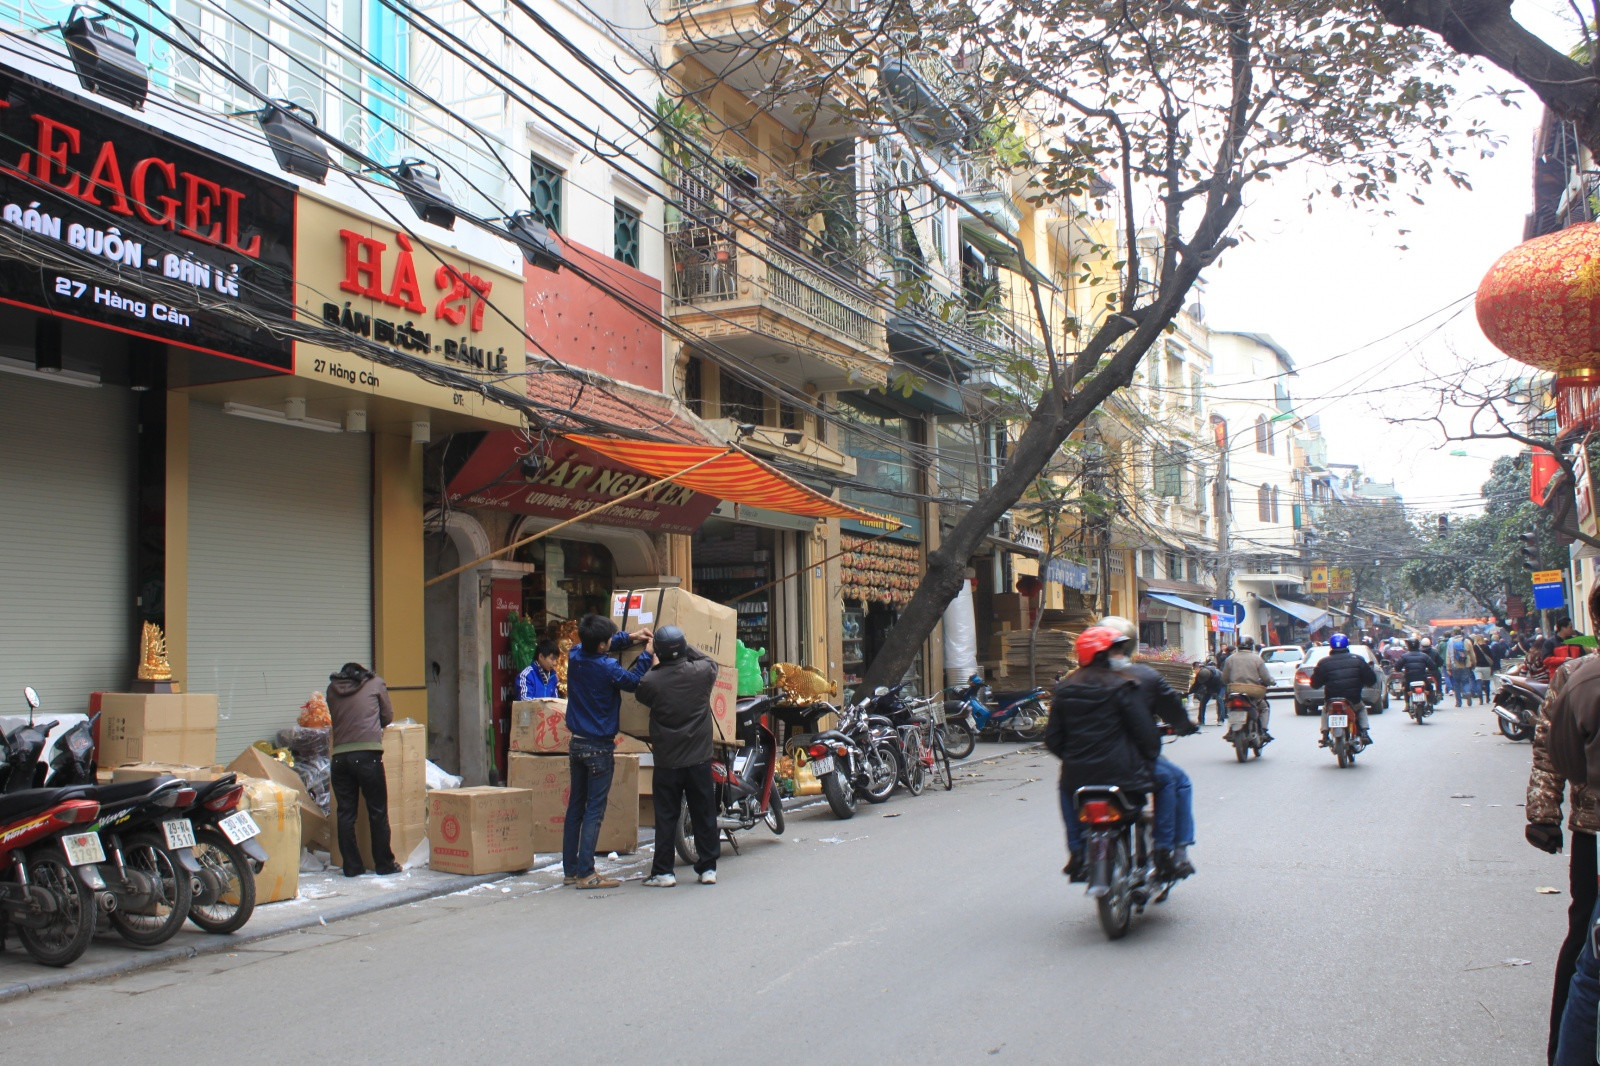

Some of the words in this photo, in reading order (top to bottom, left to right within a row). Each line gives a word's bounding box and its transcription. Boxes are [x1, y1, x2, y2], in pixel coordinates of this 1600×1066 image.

[3, 201, 61, 240] BÁN
[67, 223, 142, 269] BUÔN
[163, 250, 211, 289] BÁN
[55, 277, 87, 299] 27
[94, 286, 147, 318] Hàng
[151, 303, 190, 327] Cân
[340, 229, 427, 314] HÀ
[435, 263, 493, 332] 27
[323, 301, 371, 337] BÁN
[374, 317, 432, 354] BUÔN
[444, 337, 485, 368] BÁN
[314, 358, 325, 373] 27
[329, 362, 356, 384] Hàng
[359, 371, 380, 387] Cân
